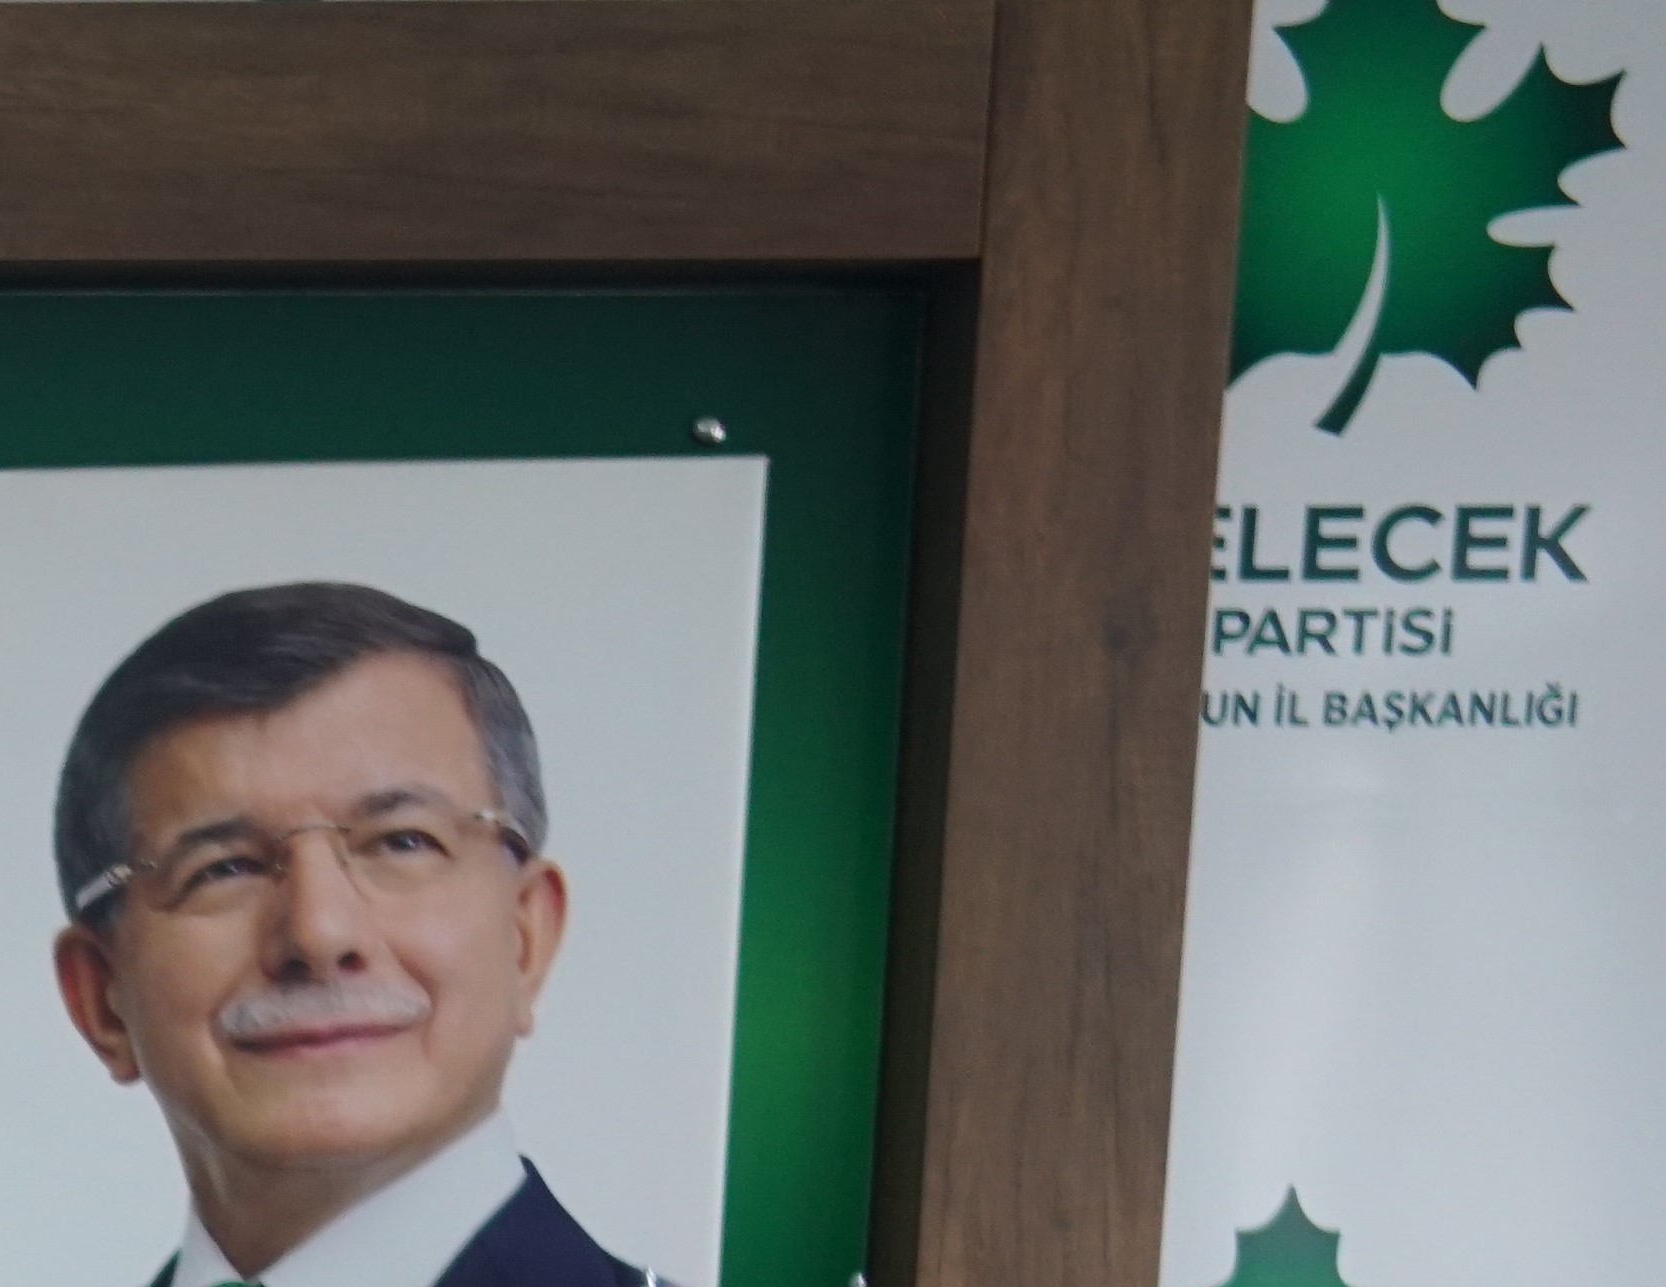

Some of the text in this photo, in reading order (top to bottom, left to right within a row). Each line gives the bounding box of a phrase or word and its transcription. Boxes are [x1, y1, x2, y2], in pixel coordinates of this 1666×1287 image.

[1211, 503, 1590, 584] LECEK
[1275, 683, 1309, 728] İL
[1322, 681, 1579, 734] BAŞKANLIĞI
